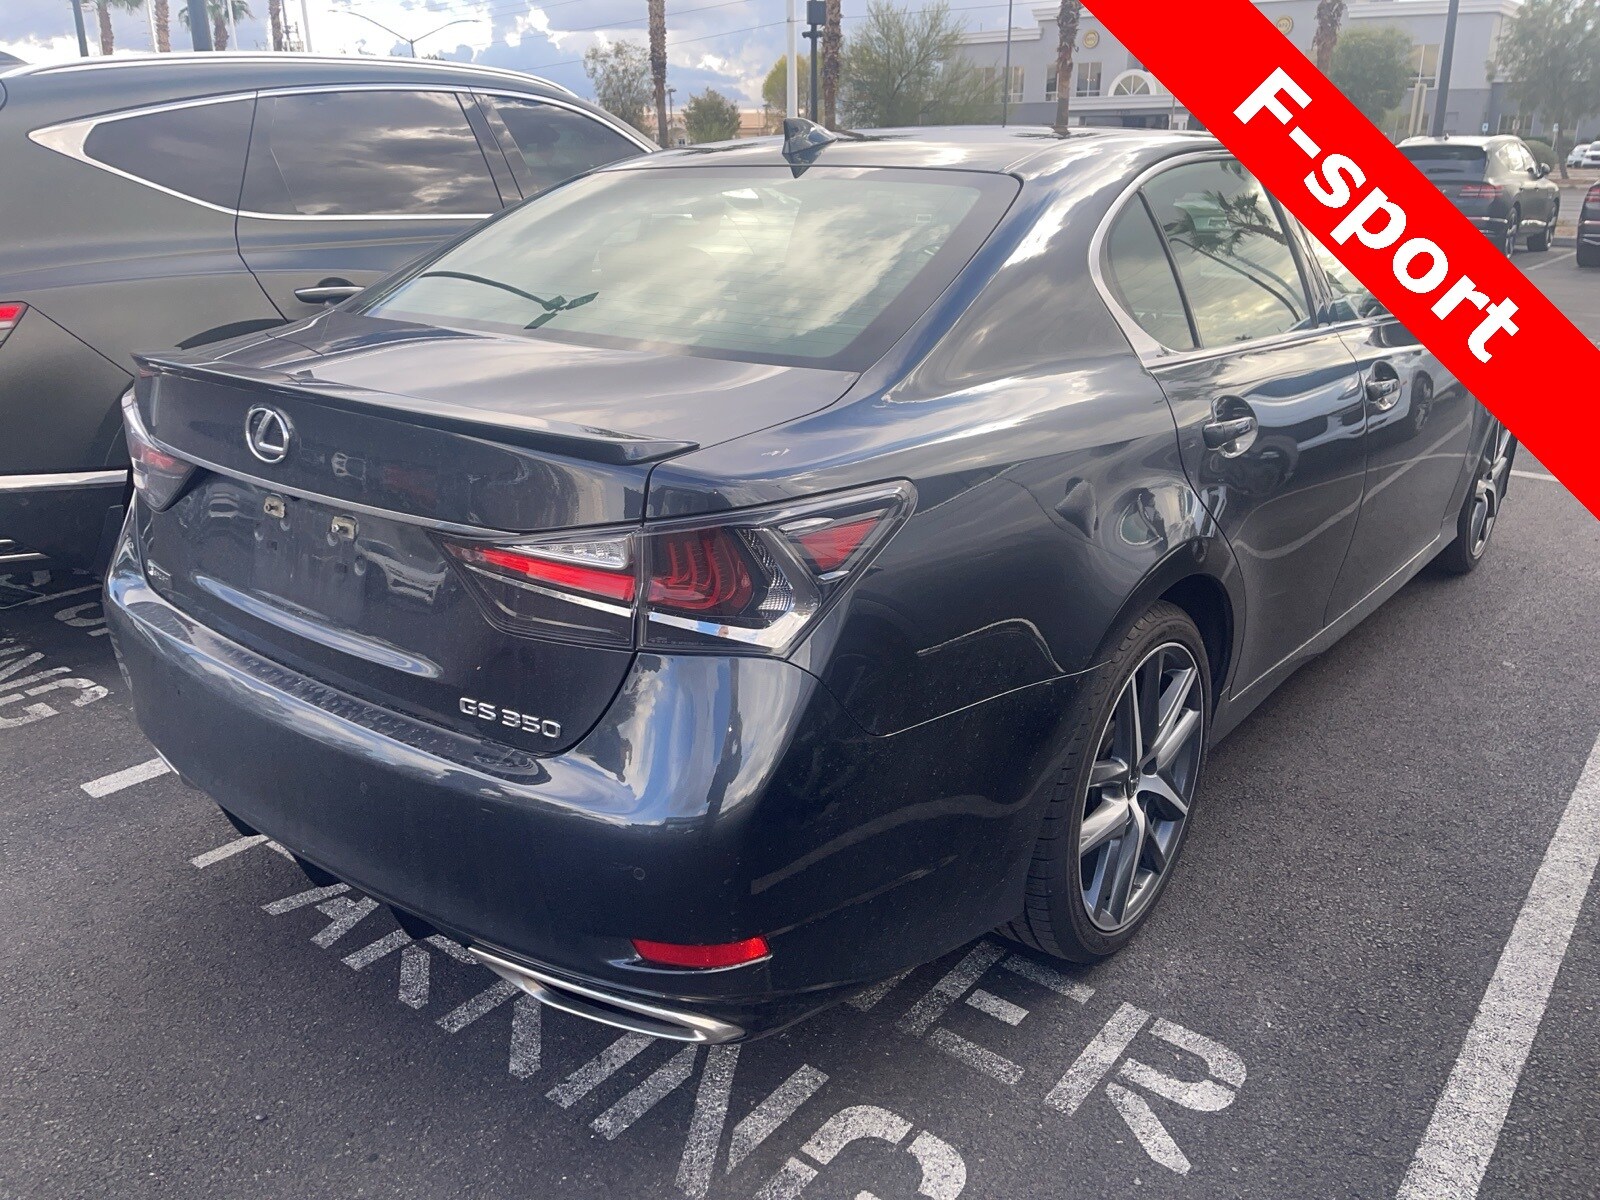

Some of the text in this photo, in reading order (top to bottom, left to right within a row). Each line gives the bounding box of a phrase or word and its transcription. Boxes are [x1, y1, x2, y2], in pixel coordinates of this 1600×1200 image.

[459, 697, 562, 738] GS 350
[848, 940, 1248, 1175] ER
